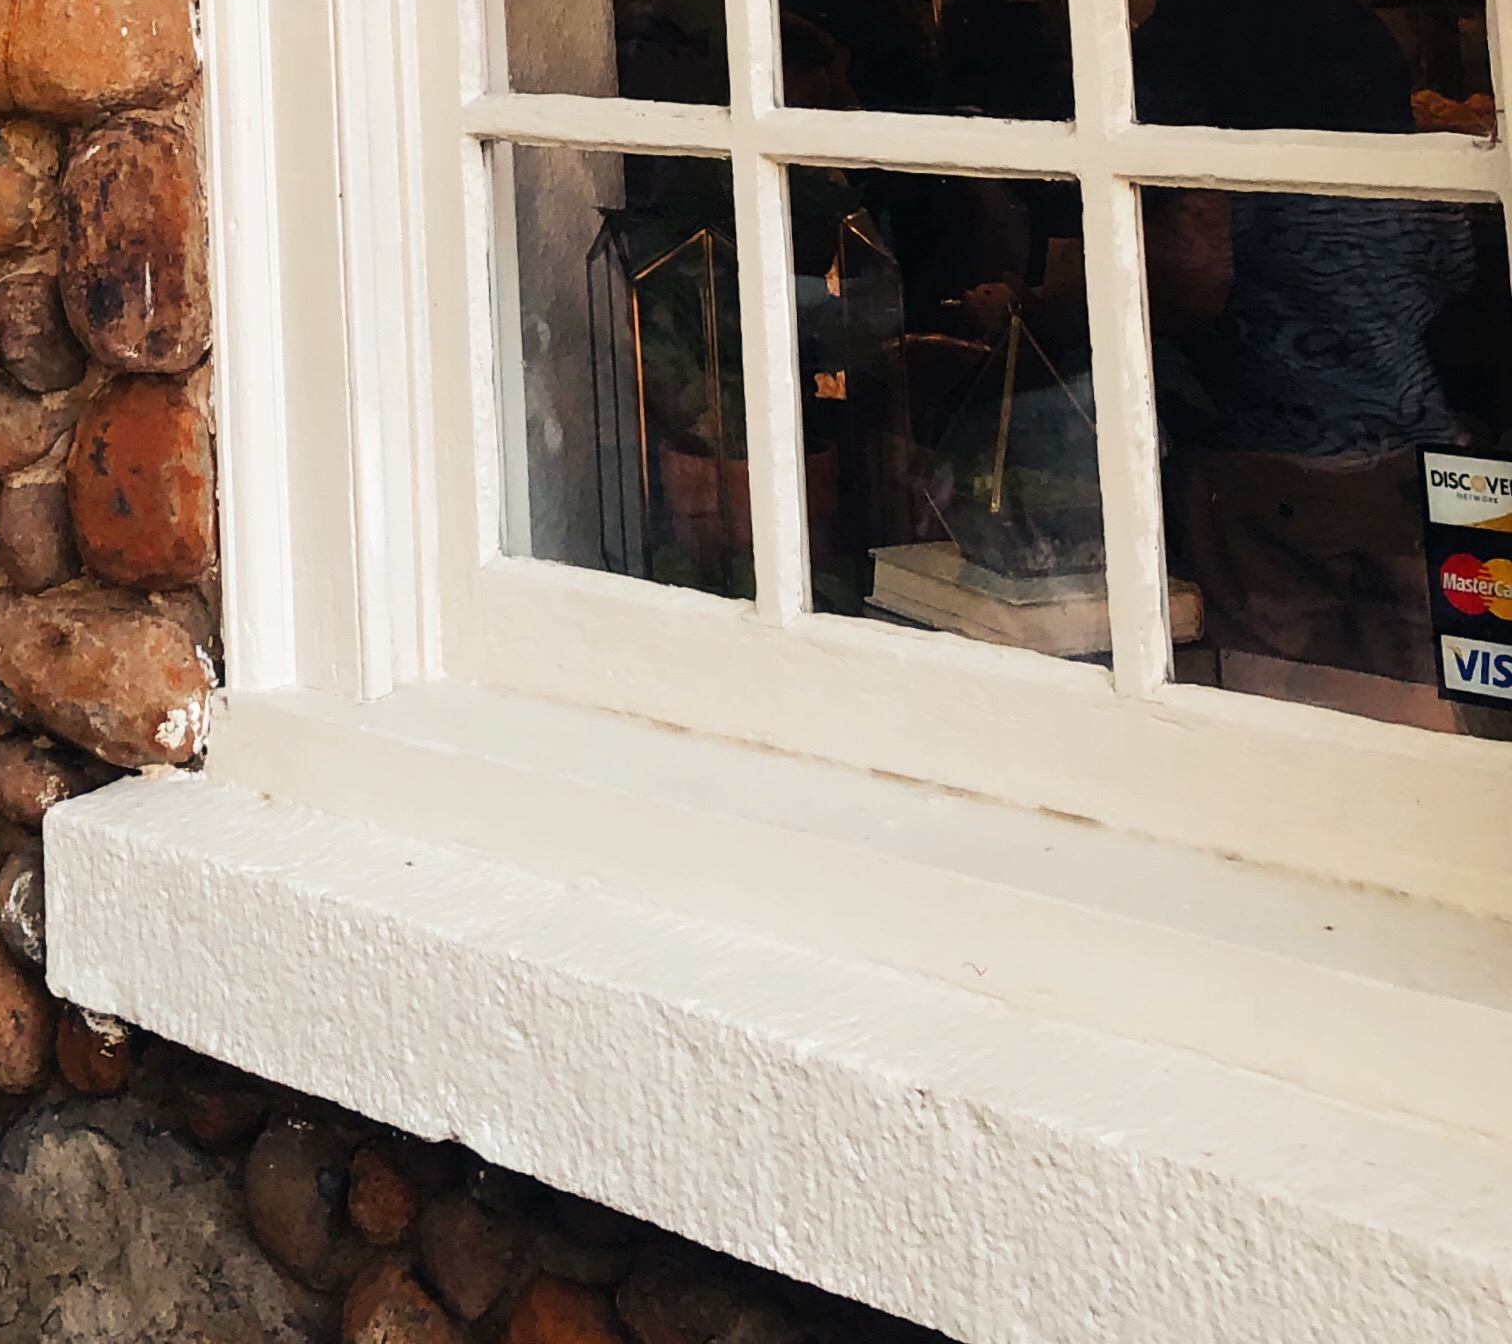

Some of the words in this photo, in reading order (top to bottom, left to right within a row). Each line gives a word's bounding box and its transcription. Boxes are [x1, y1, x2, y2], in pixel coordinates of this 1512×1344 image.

[1430, 469, 1512, 496] DISCOVE
[1442, 572, 1512, 598] MasterCa
[1451, 646, 1512, 689] VIS
